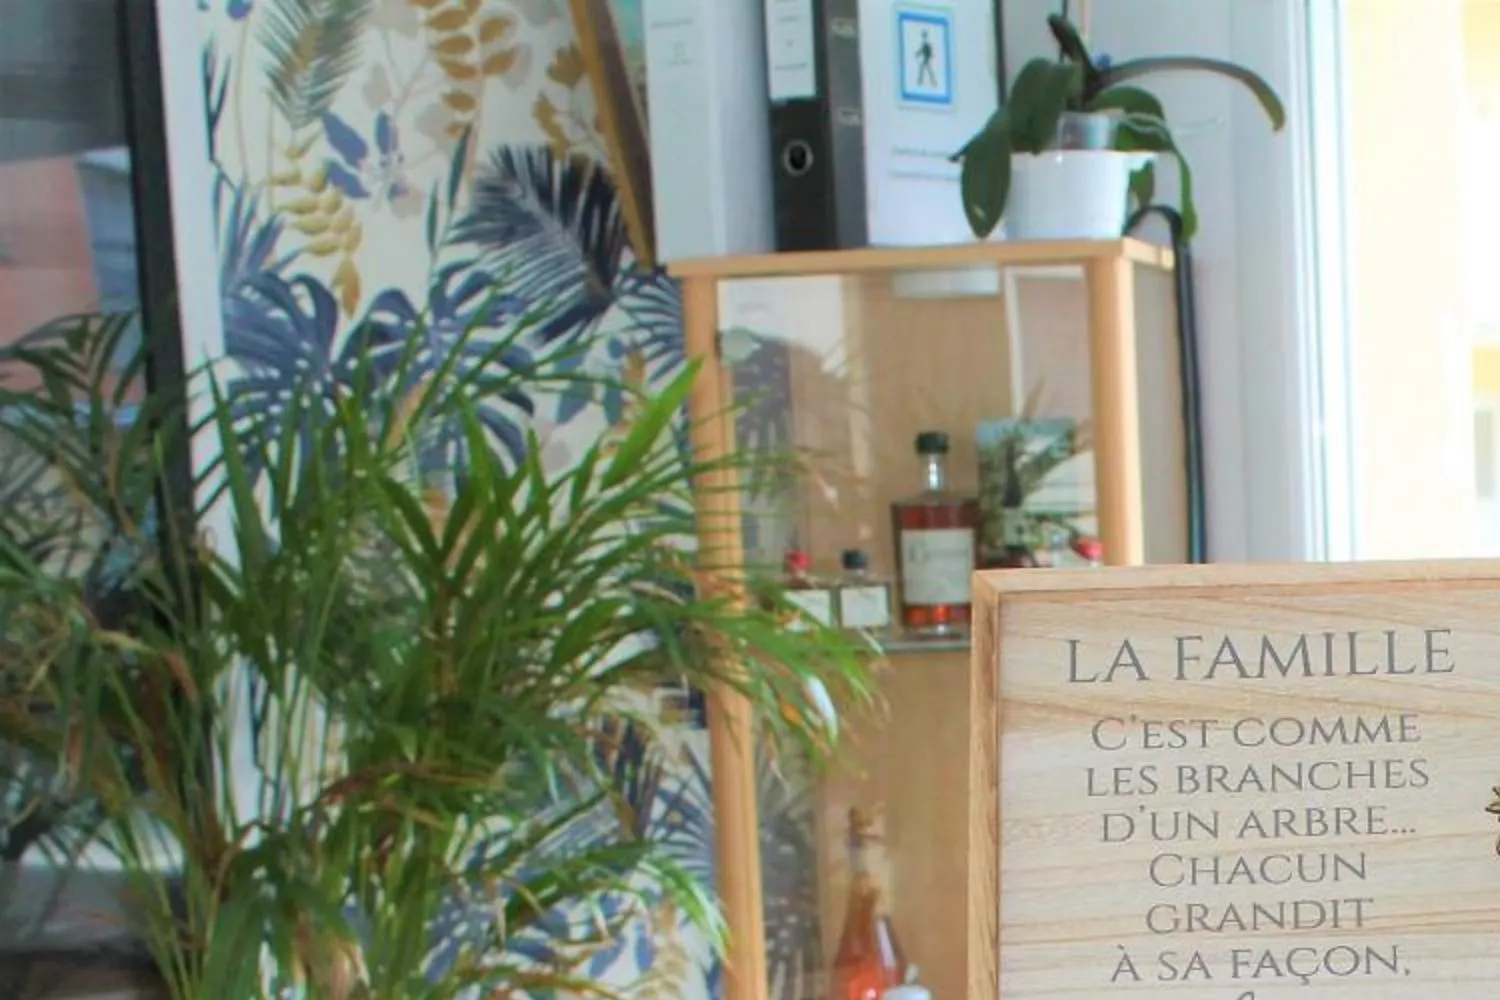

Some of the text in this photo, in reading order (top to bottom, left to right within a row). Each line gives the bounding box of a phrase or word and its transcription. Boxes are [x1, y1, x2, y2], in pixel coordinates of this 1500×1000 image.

[1067, 629, 1456, 684] LA FAMILLE
[1091, 713, 1422, 752] C'EST COMME
[1086, 758, 1430, 798] LES BRANCHES
[1102, 804, 1417, 843] D'UN ARBRE...
[1149, 852, 1367, 888] CHACUN
[1145, 897, 1374, 935] GRANDIT
[1110, 945, 1140, 982] À
[1158, 950, 1213, 981] SA
